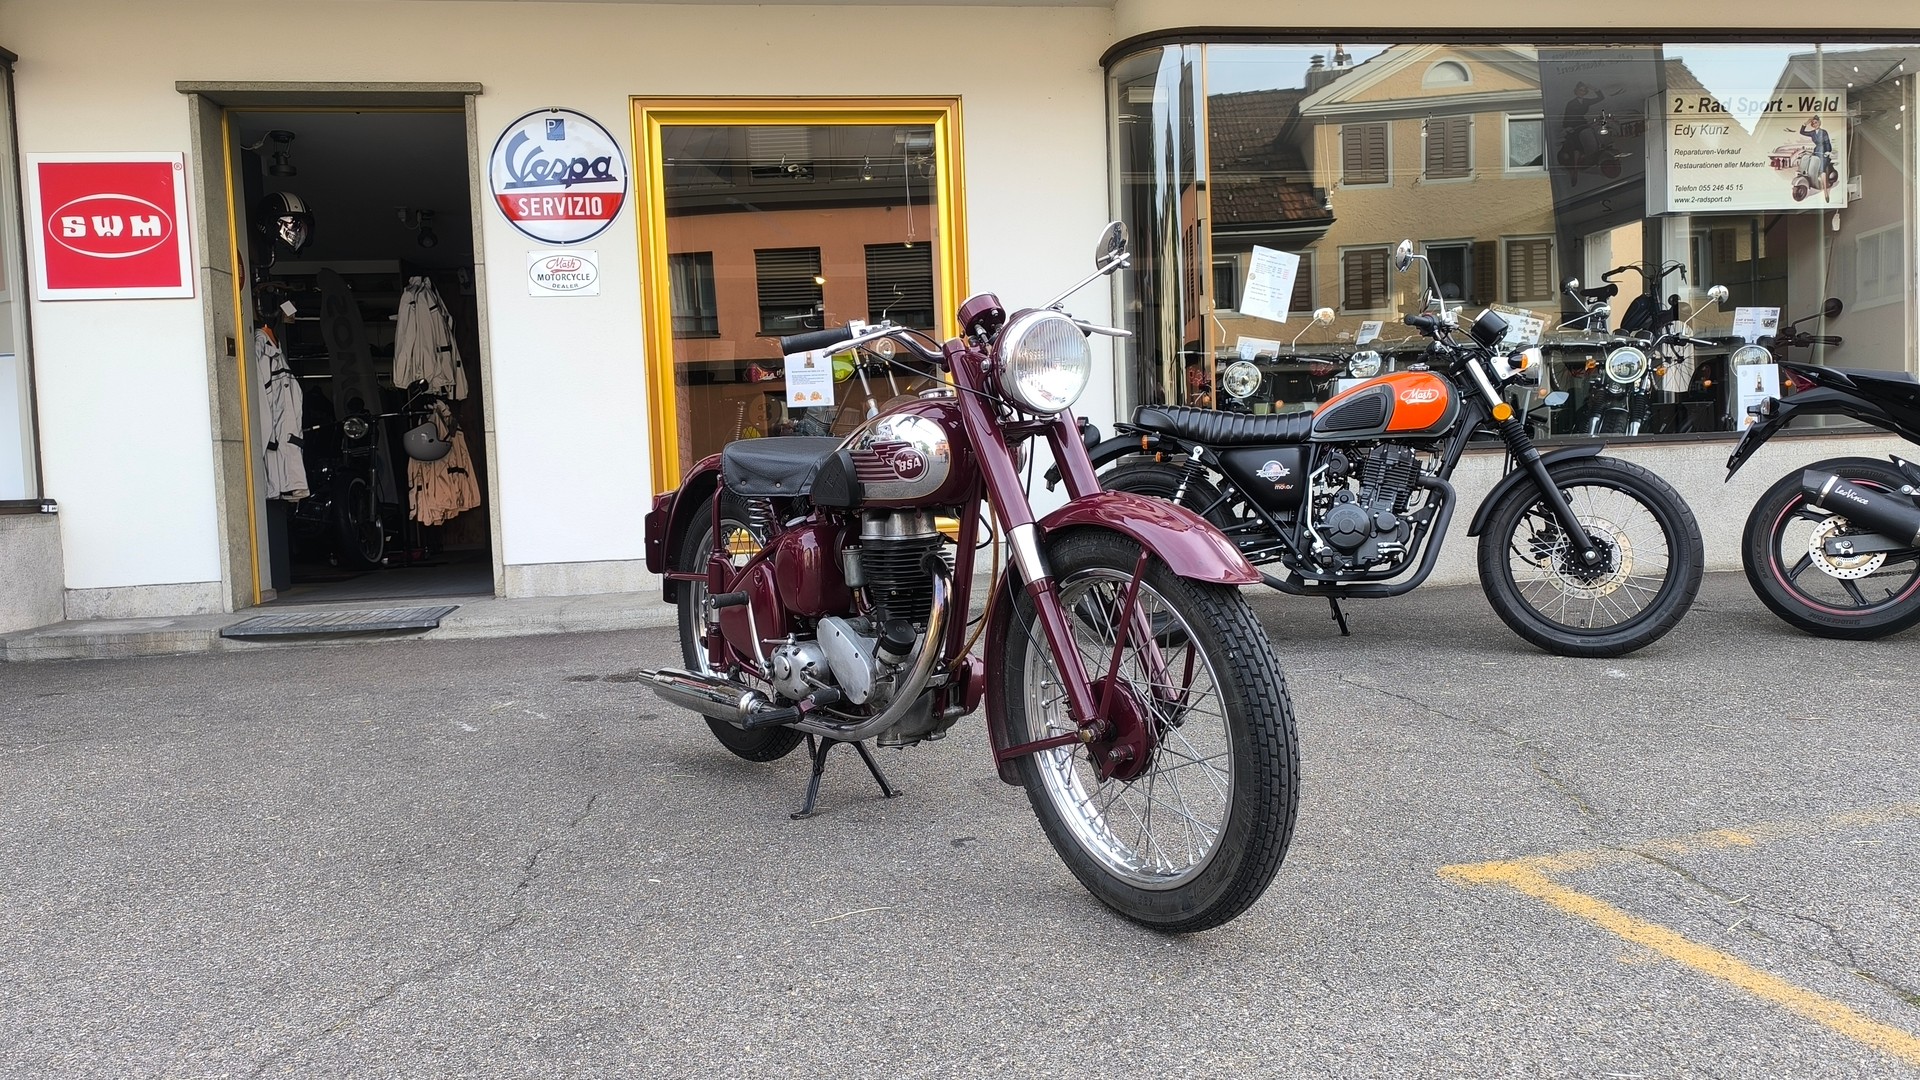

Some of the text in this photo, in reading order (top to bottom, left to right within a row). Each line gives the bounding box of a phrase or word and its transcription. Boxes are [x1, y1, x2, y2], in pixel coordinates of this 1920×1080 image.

[1674, 98, 1684, 113] 2
[1698, 97, 1732, 113] Rad
[1737, 96, 1783, 116] Sport
[1798, 96, 1839, 112] Wald
[1674, 123, 1730, 138] Edy Kunz
[503, 129, 618, 190] Vespa
[1674, 148, 1742, 157] Reparaturen-Verkauf
[518, 196, 603, 217] SERVIZIO
[60, 215, 161, 238] SWM
[549, 257, 579, 270] Mash
[537, 273, 591, 281] MOTORCYCLE
[898, 457, 922, 472] BSA
[1834, 485, 1869, 505] LeoVince
